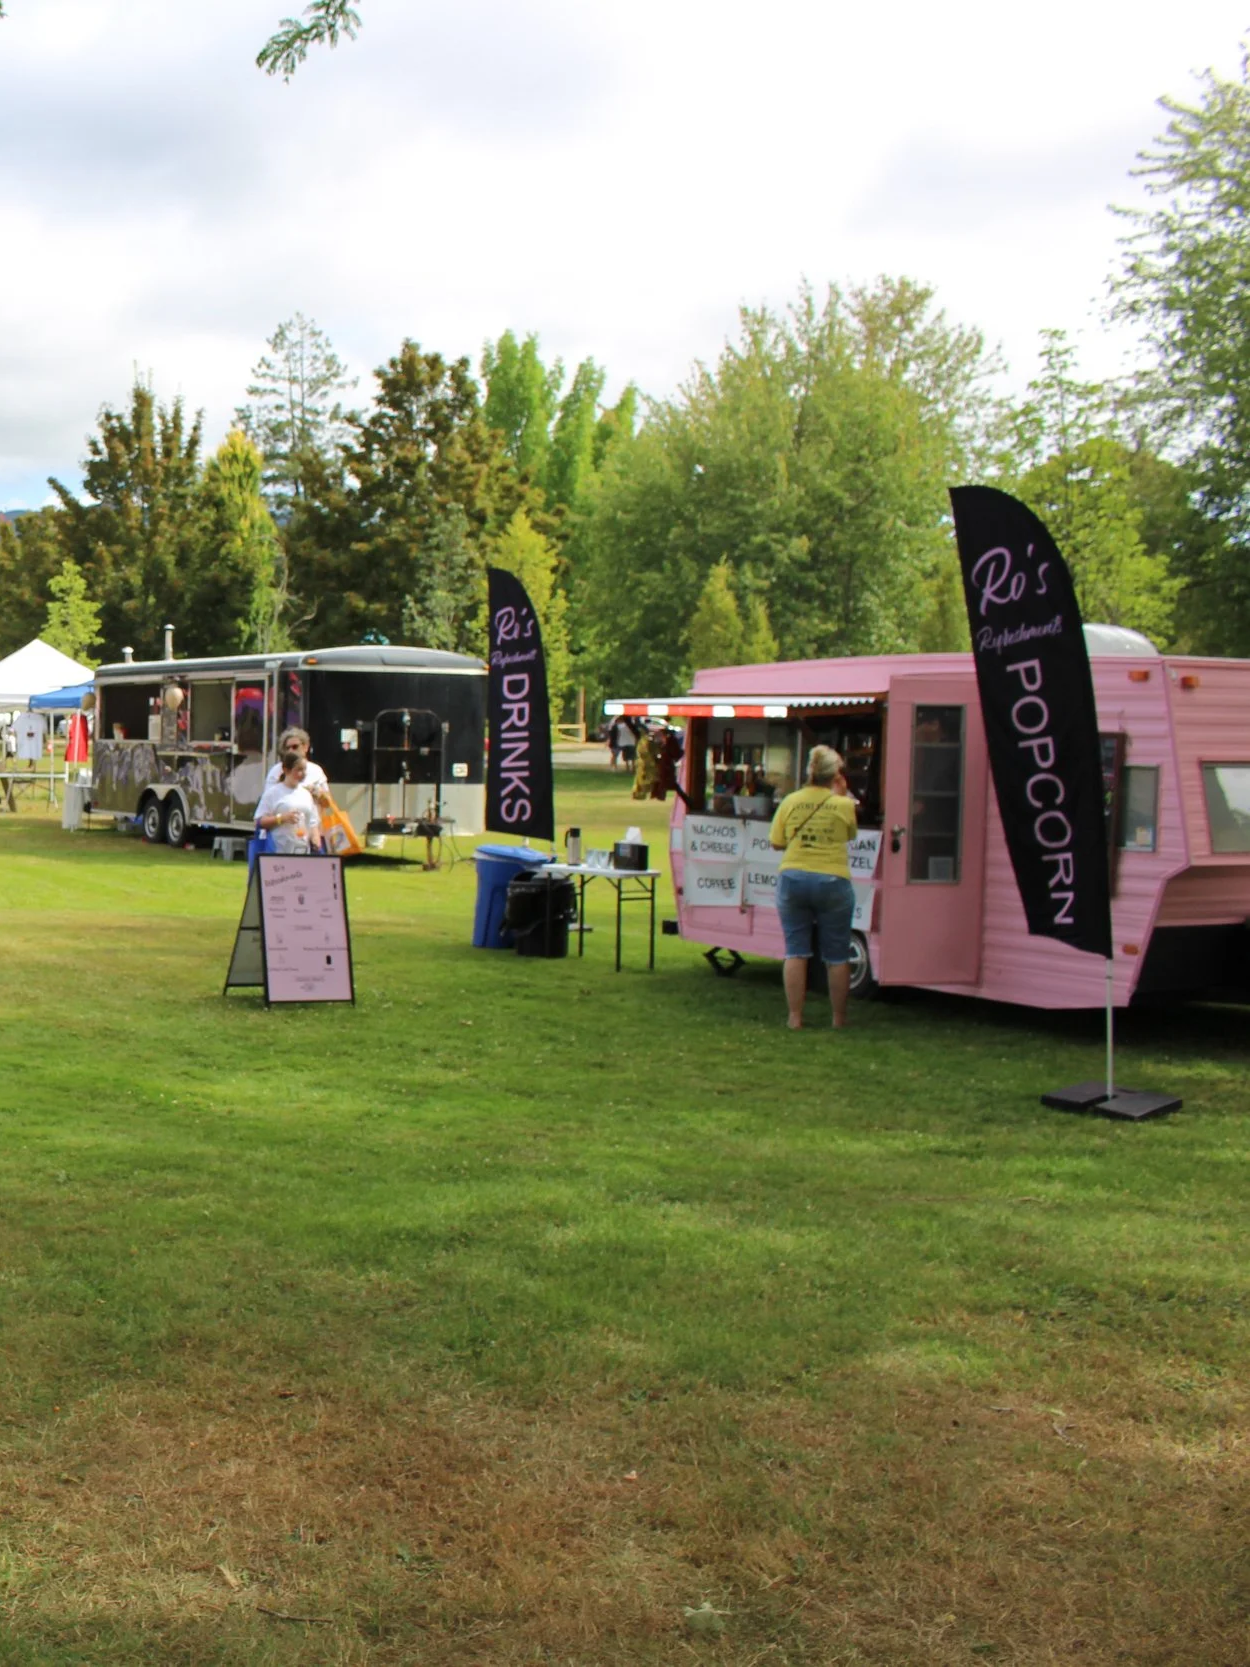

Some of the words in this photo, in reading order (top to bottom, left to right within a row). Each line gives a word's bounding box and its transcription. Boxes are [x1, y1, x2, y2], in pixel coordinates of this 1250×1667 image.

[500, 673, 531, 823] DRINKS
[1006, 658, 1075, 925] POPCORN
[691, 823, 737, 838] NACHOS
[691, 840, 698, 852] &
[700, 840, 738, 855] CHEESE
[696, 876, 737, 890] COFFEE
